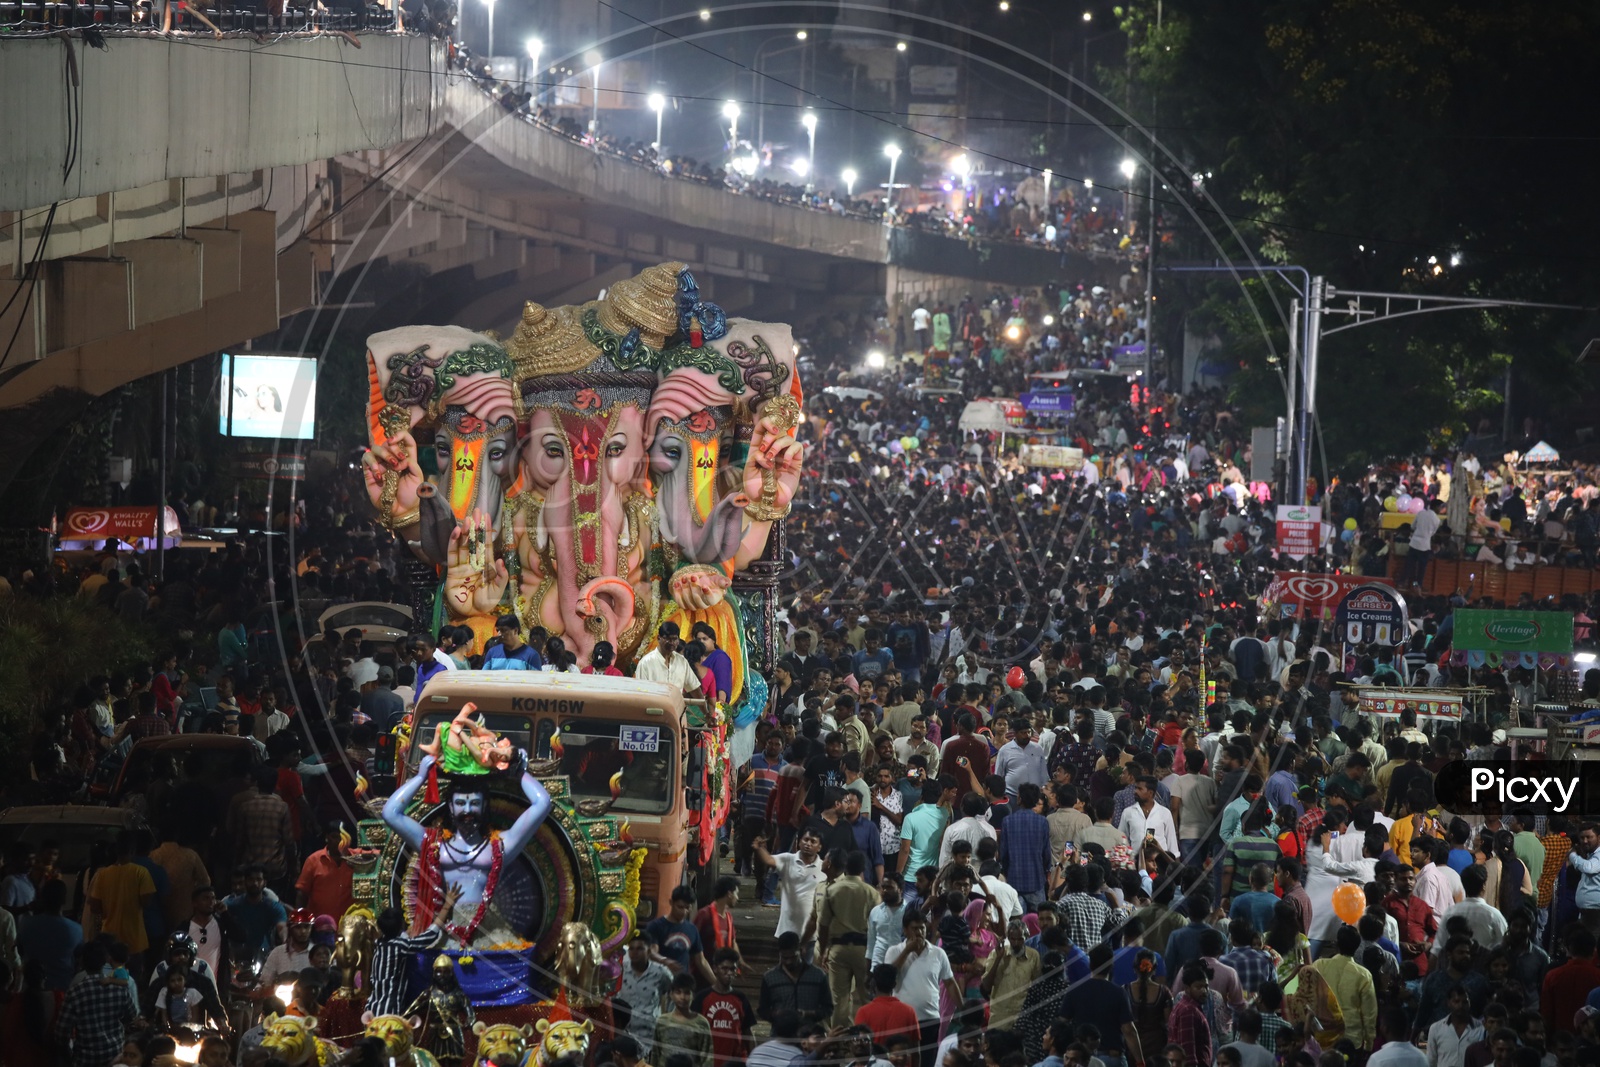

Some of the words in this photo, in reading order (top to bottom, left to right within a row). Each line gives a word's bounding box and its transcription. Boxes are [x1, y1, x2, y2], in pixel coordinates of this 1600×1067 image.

[1347, 611, 1359, 619] Ice
[1361, 612, 1392, 621] Creams
[1491, 624, 1535, 636] Heritage
[511, 697, 585, 714] KON16W
[1376, 701, 1385, 710] 20
[1397, 702, 1406, 710] 30
[1419, 703, 1427, 711] 40
[1441, 705, 1450, 713] 50
[706, 1000, 740, 1021] AMERICAN
[713, 1019, 733, 1029] EAGLE
